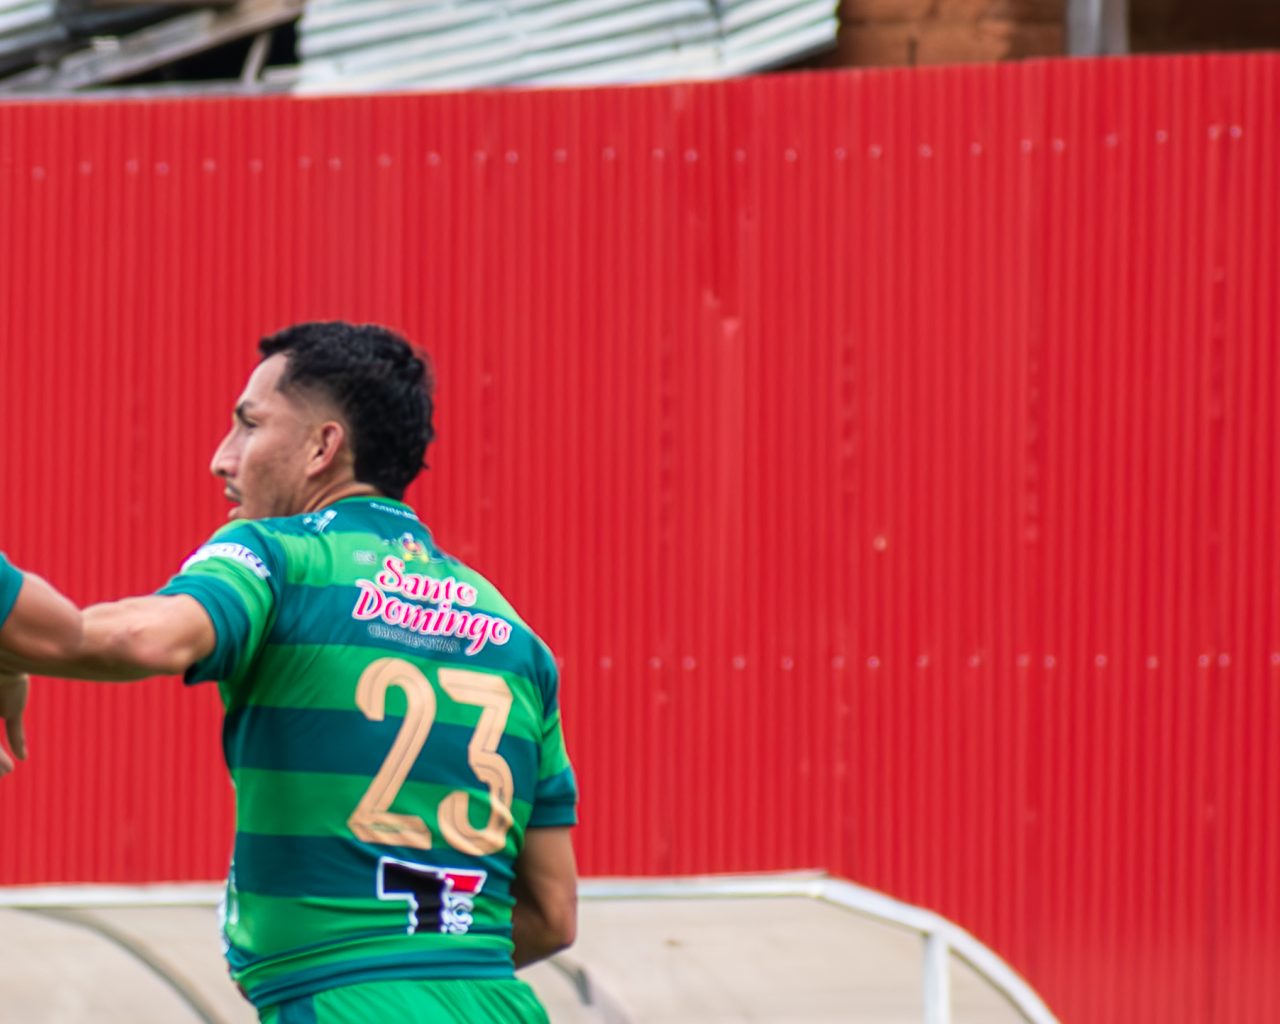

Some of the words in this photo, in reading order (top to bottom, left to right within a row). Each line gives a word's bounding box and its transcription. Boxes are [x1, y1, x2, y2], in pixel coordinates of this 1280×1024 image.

[352, 579, 512, 656] Domingo
[375, 555, 478, 607] Santo
[347, 657, 514, 856] 23
